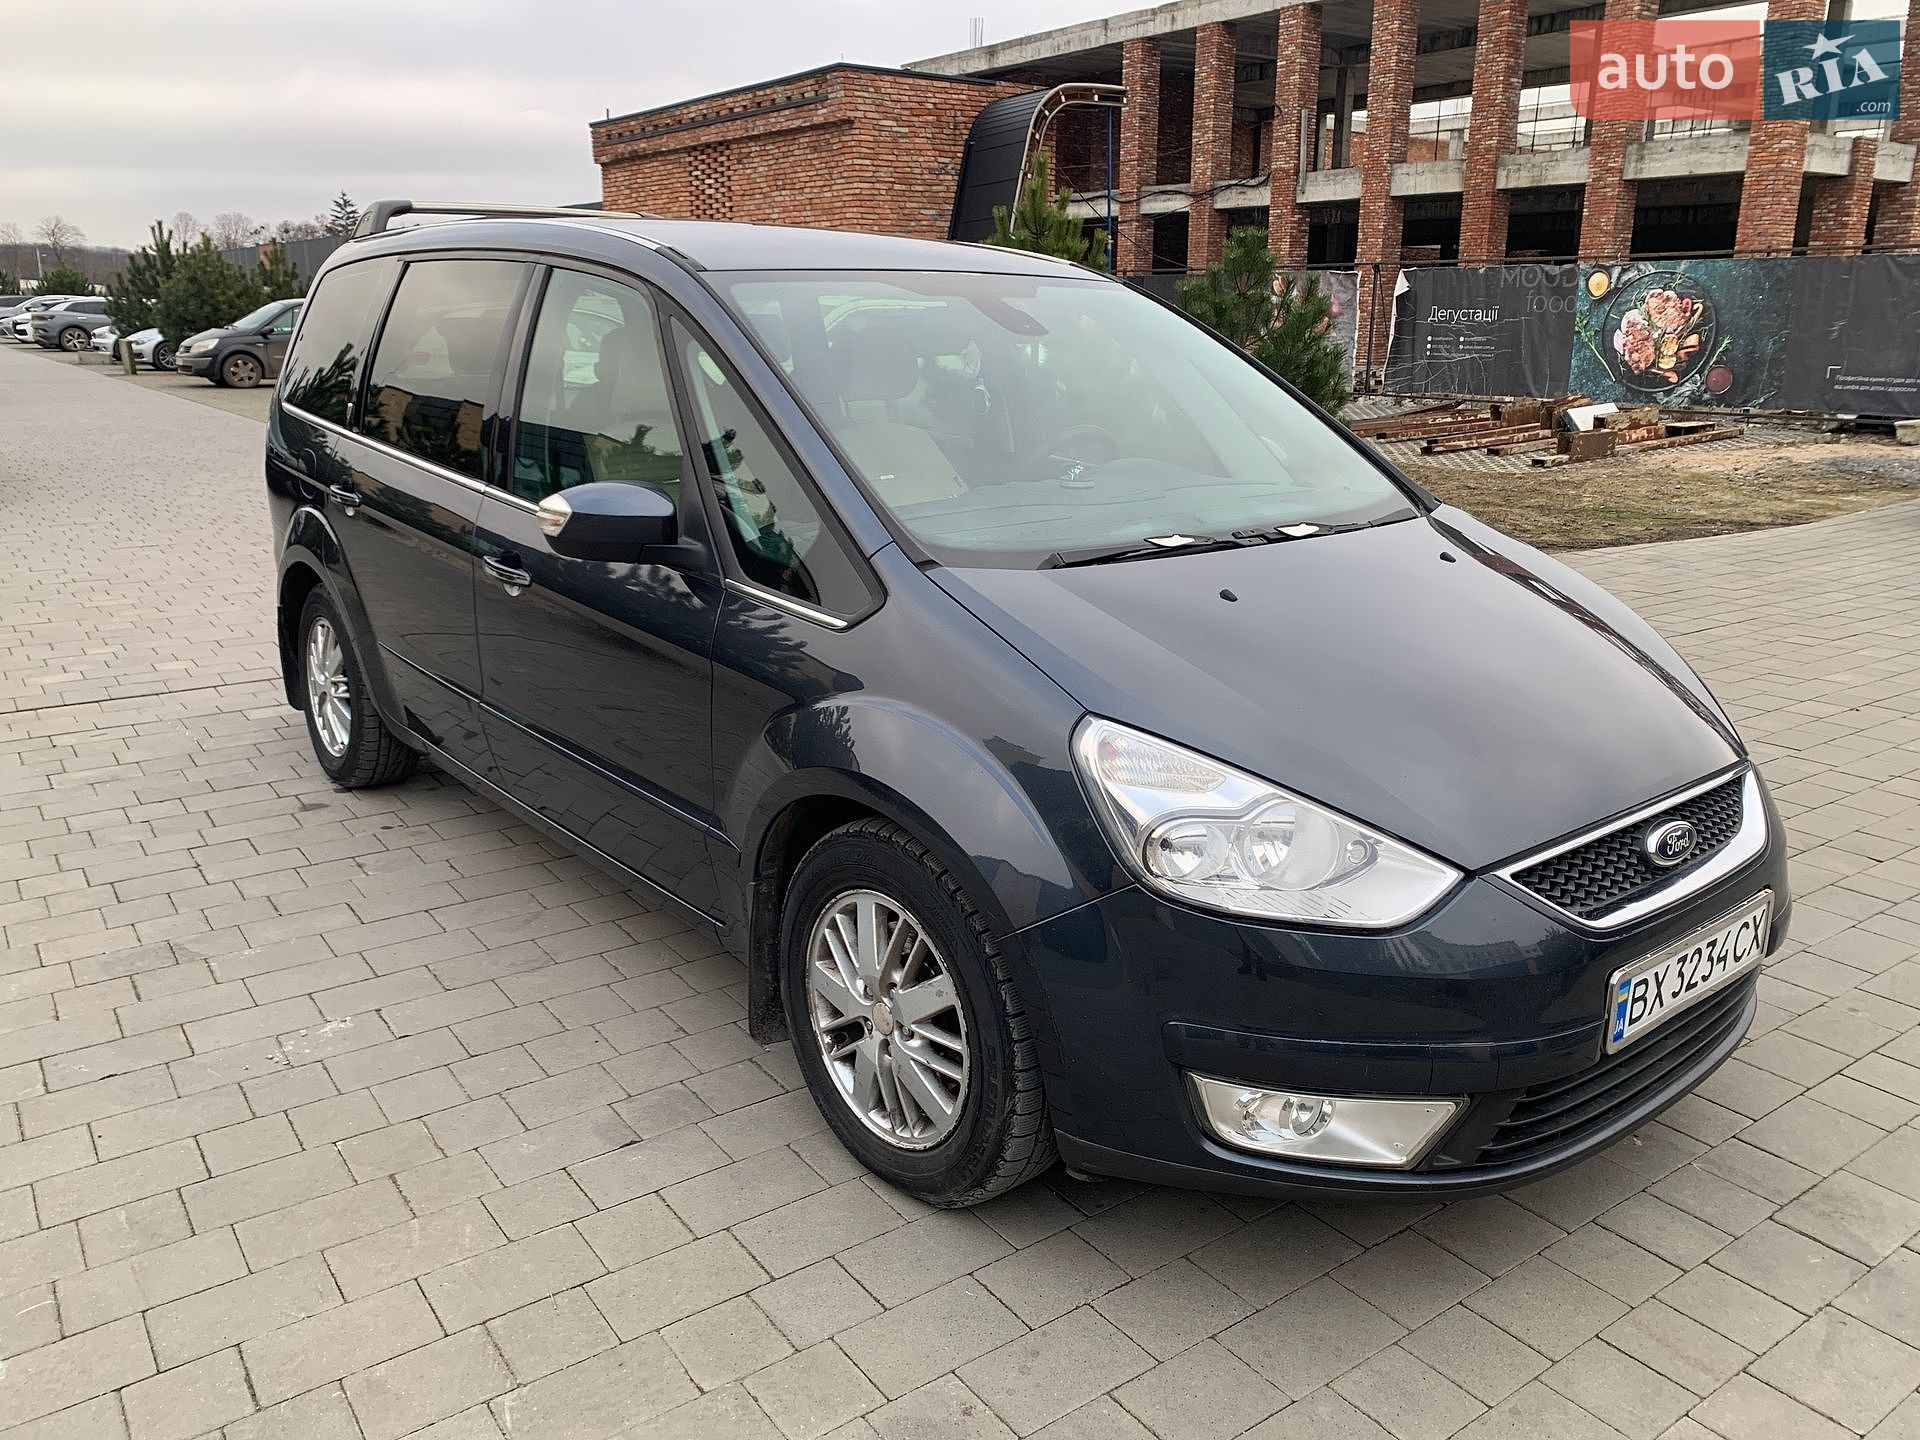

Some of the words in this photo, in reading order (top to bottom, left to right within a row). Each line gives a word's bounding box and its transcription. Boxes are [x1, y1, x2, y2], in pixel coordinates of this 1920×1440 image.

[1501, 265, 1578, 288] MOOD
[1427, 305, 1499, 324] Дегустації
[1666, 830, 1689, 855] Ford
[1628, 963, 1670, 1027] BX
[1671, 930, 1732, 999] 3234
[1733, 909, 1766, 963] CX
